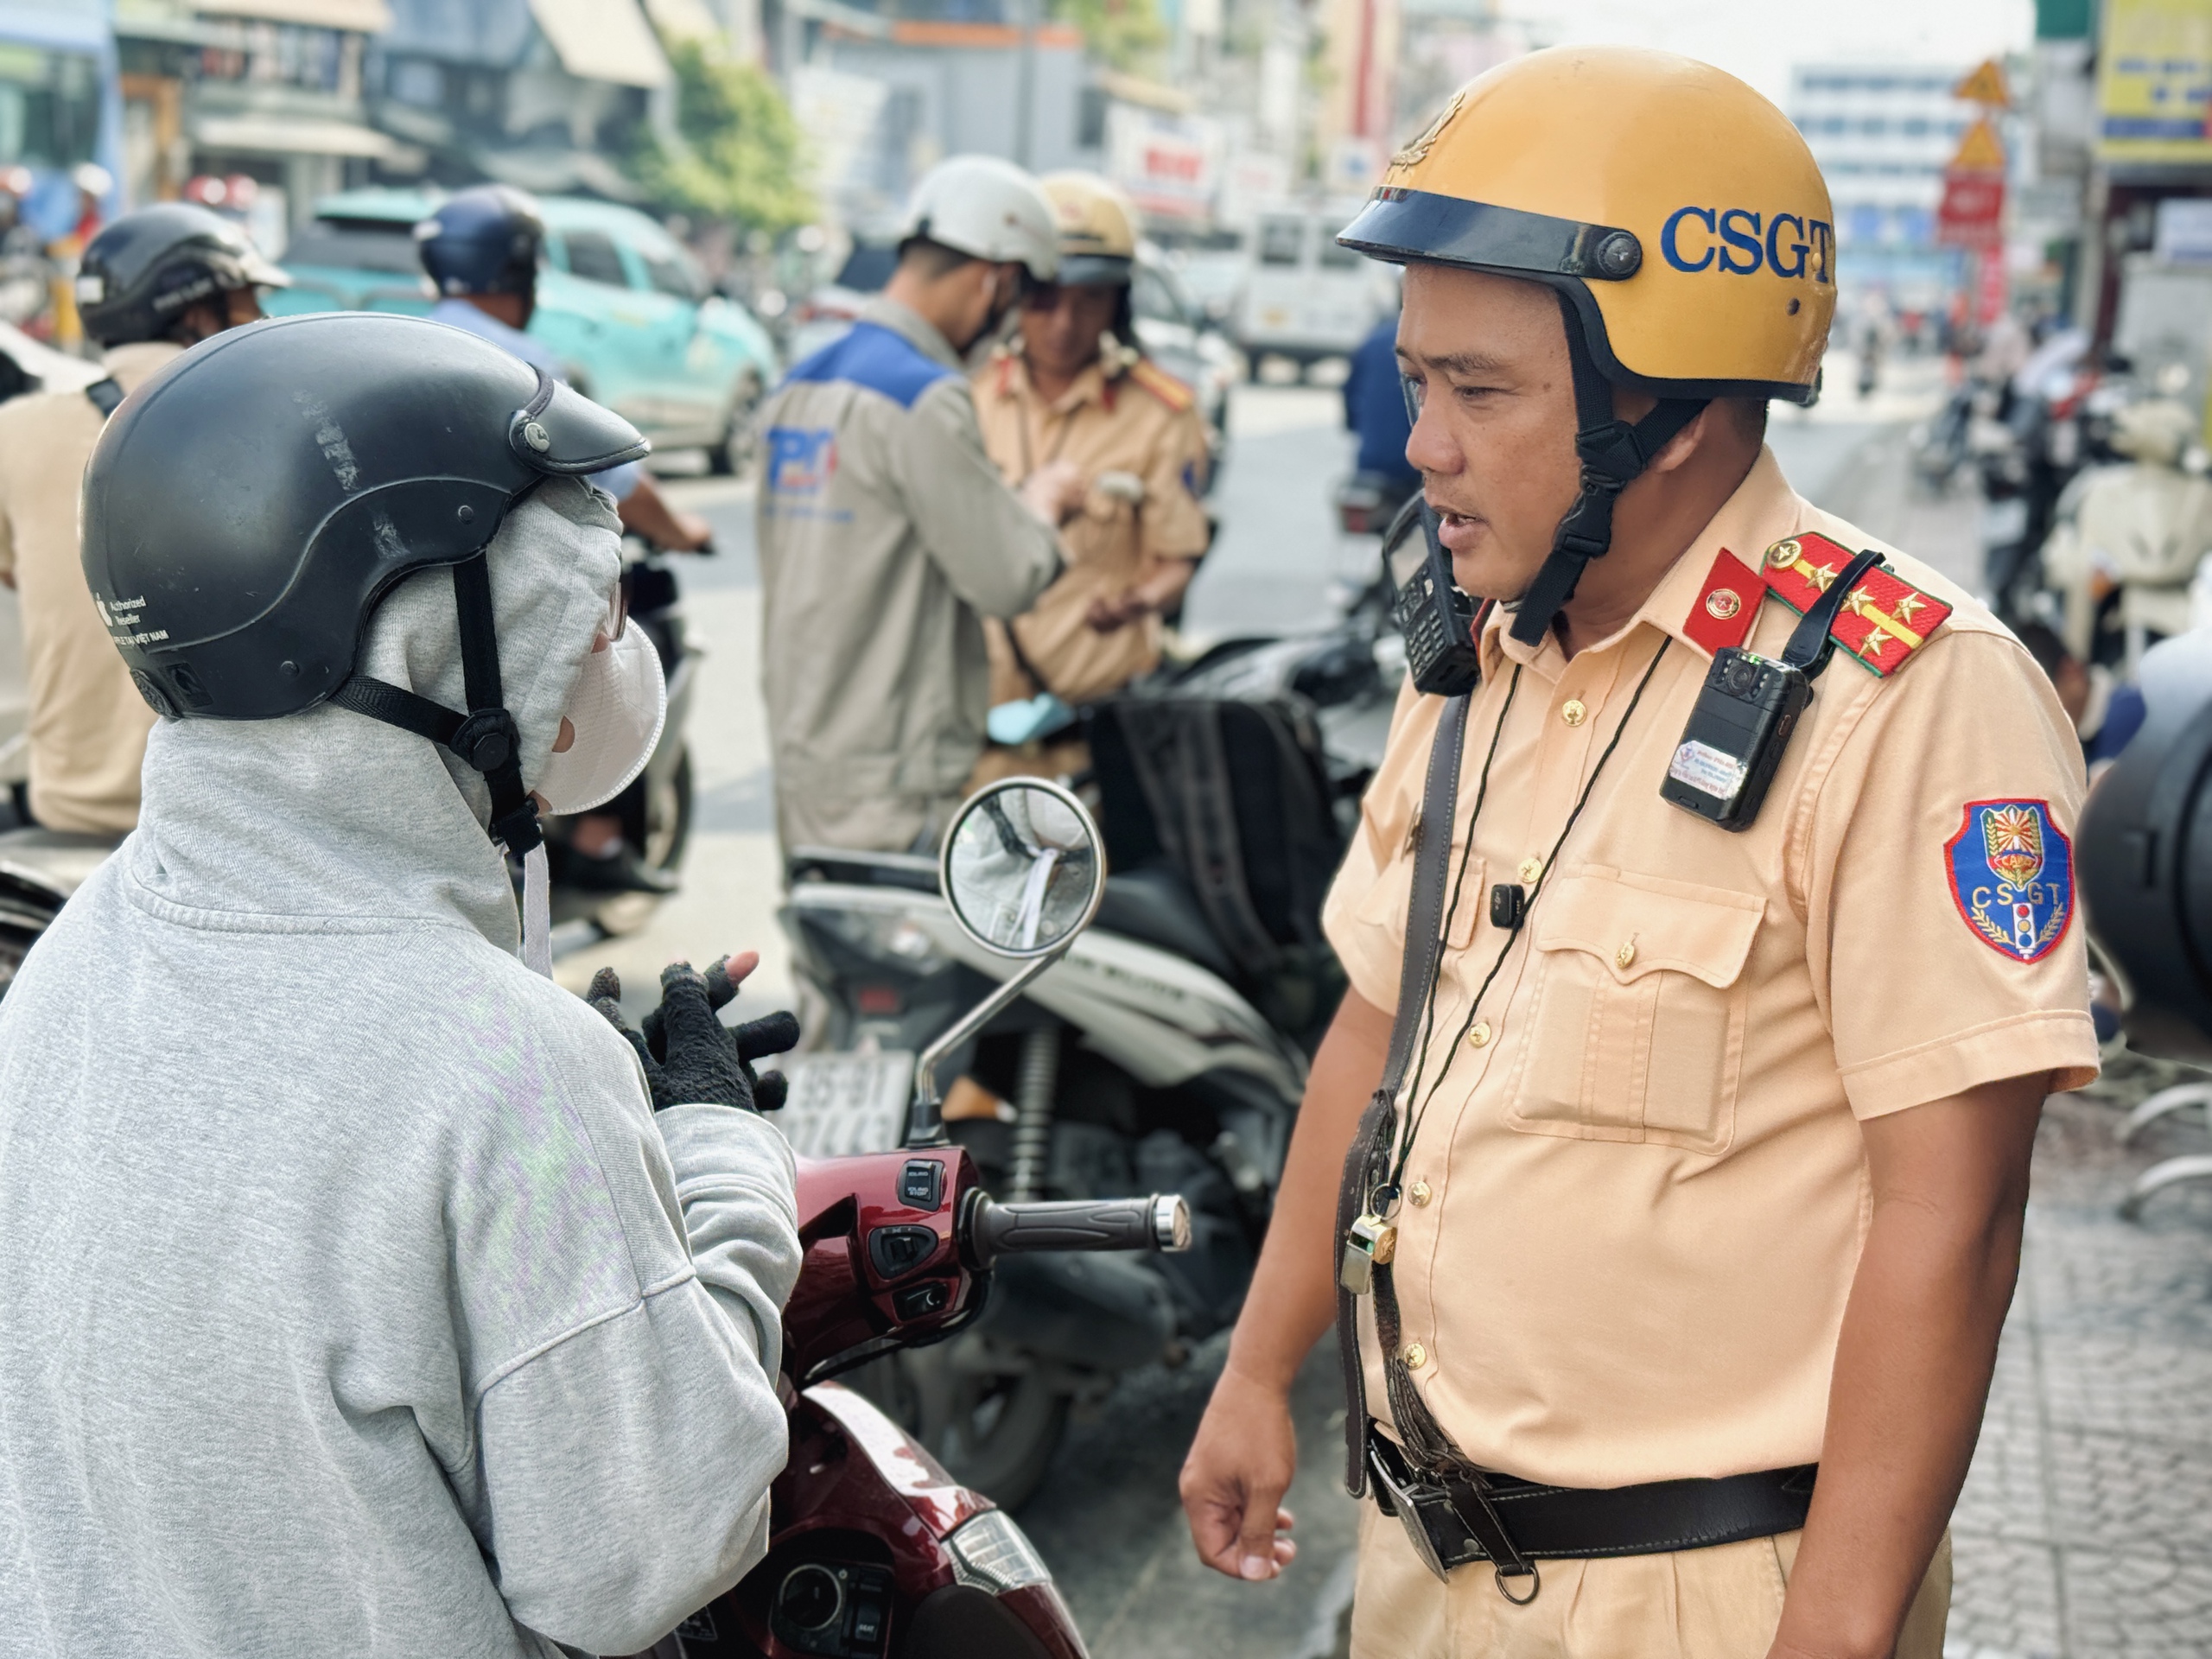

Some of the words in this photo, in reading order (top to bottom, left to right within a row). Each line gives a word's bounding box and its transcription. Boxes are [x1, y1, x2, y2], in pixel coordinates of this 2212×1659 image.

[1661, 206, 1832, 284] CSGT
[149, 629, 170, 642] NAM
[1972, 881, 2061, 909] CSGT
